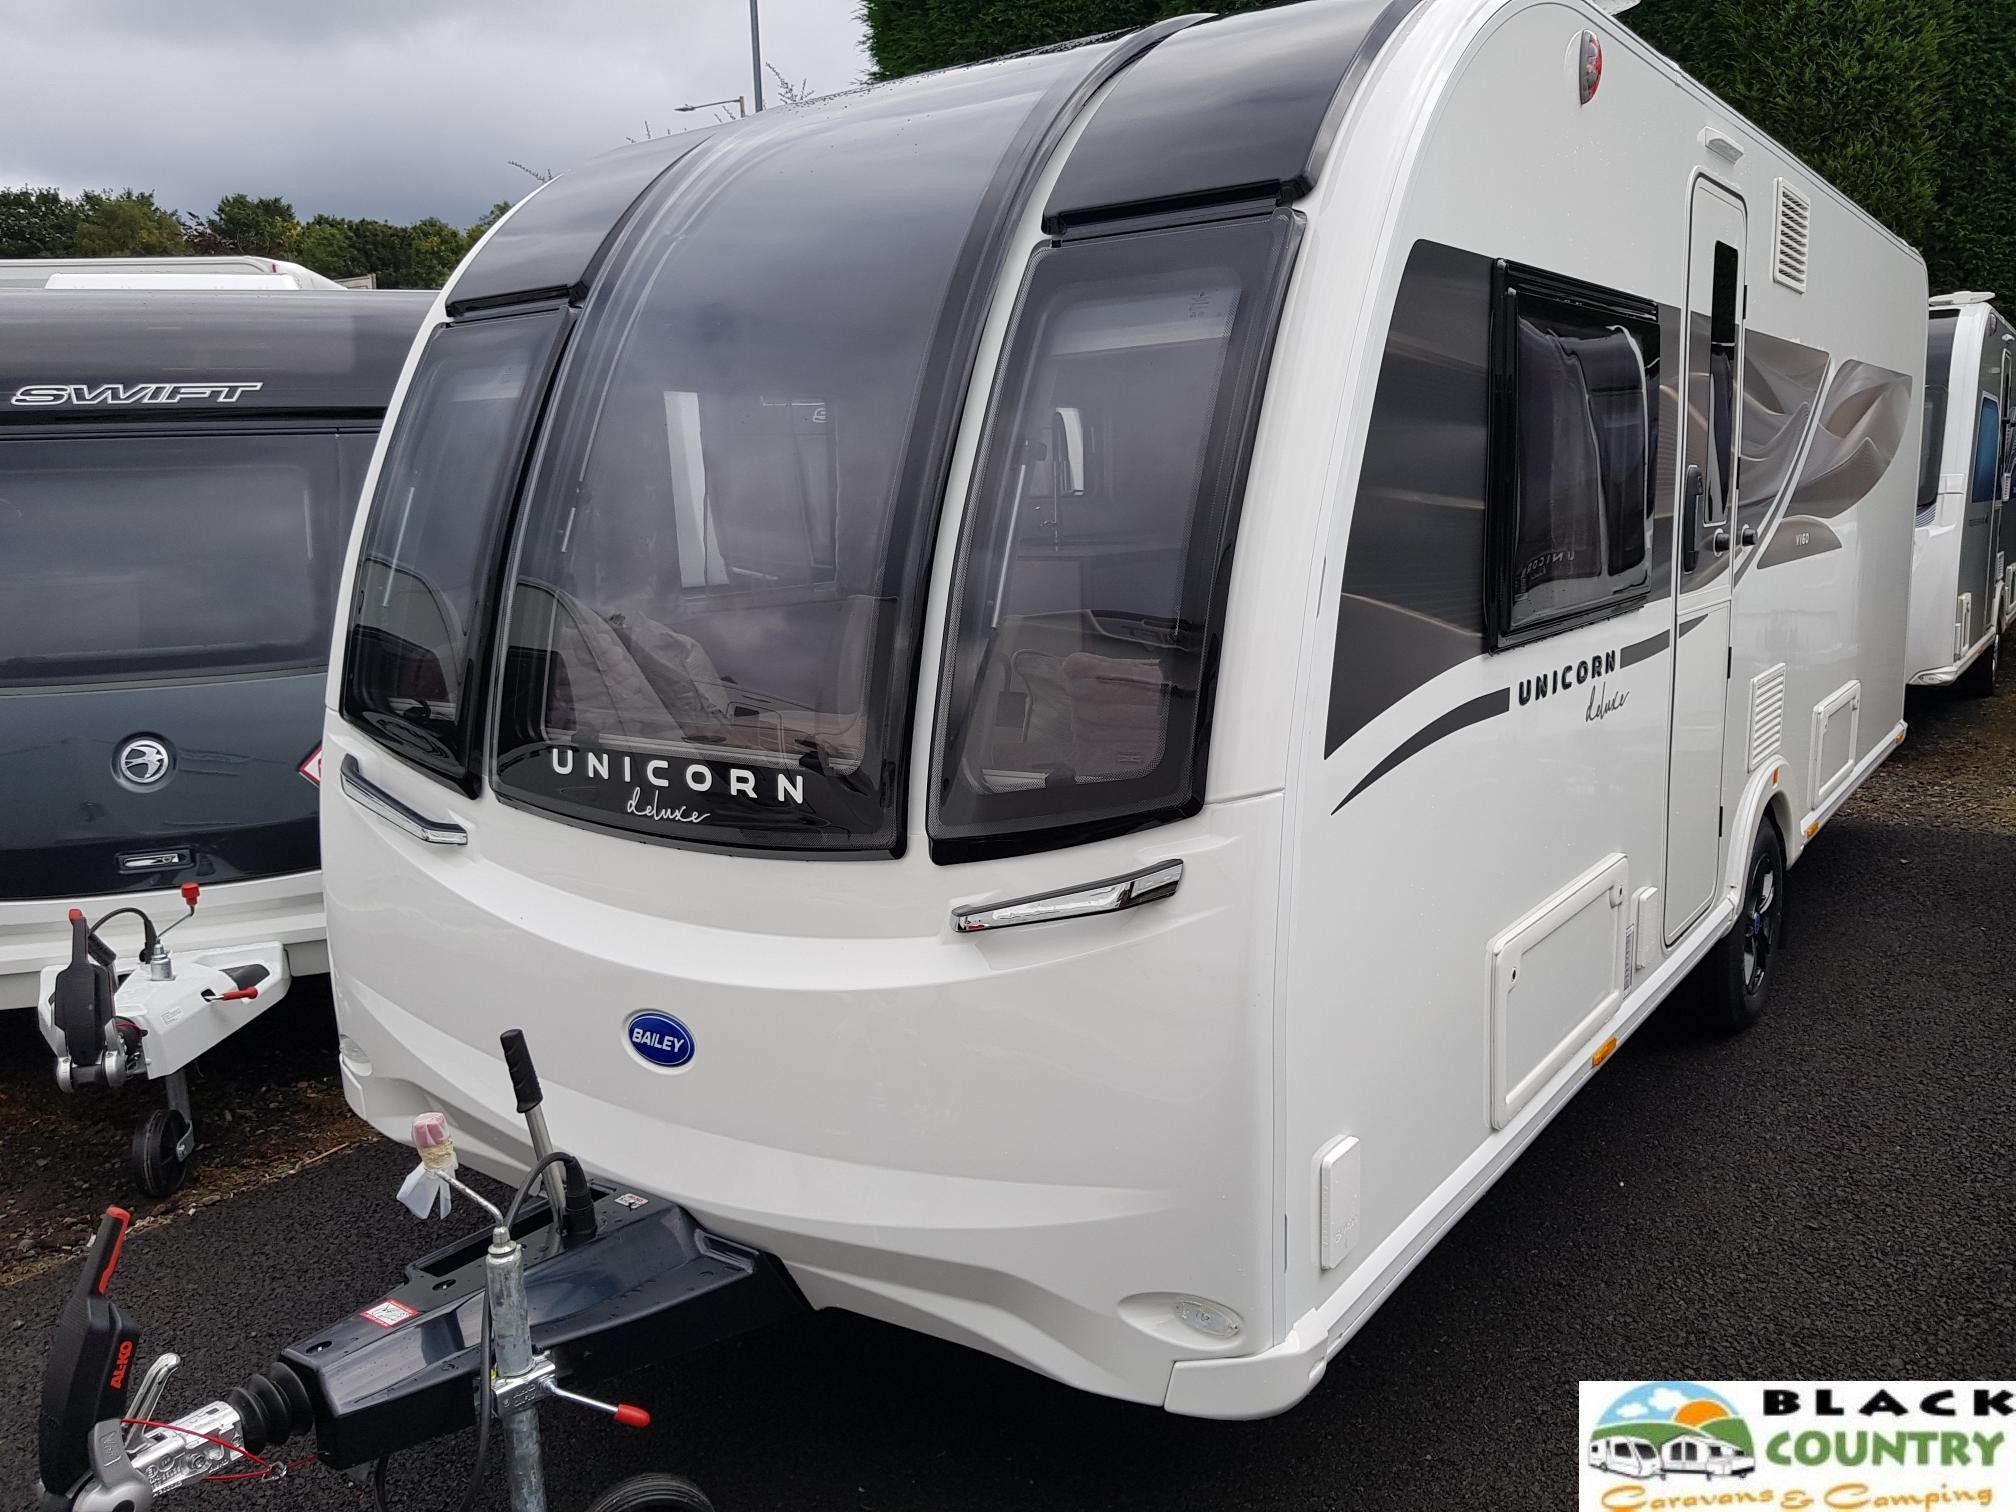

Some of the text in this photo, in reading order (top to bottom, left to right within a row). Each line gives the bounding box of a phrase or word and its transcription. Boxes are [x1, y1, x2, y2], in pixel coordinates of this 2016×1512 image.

[12, 382, 263, 406] SWIFT
[1519, 651, 1616, 706] UNICORN
[1585, 681, 1629, 722] deluxe
[552, 748, 805, 804] UNICORN
[626, 787, 711, 823] deluxe
[632, 1028, 685, 1053] BAILEY
